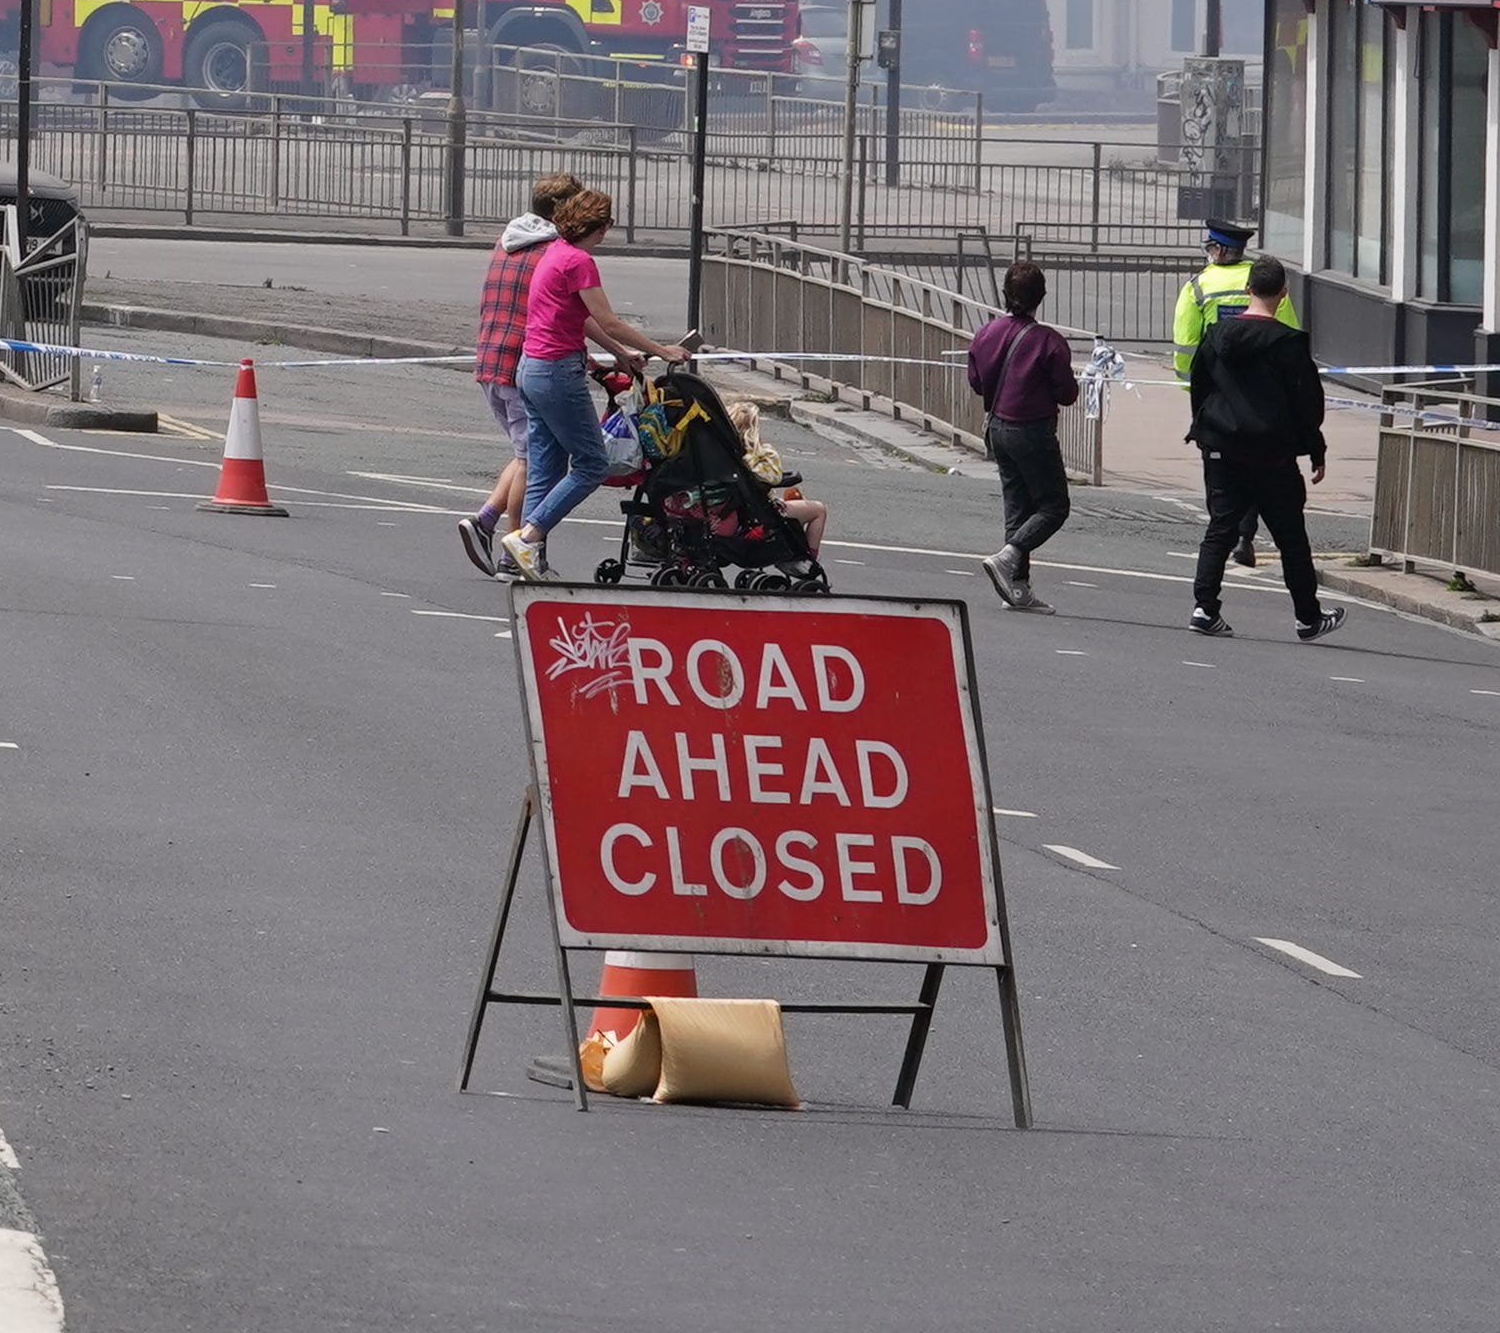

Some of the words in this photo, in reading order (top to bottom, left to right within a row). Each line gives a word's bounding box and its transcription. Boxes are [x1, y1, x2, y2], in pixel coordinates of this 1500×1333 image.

[627, 638, 867, 713] ROAD
[617, 730, 910, 809] AHEAD
[599, 823, 944, 906] CLOSED
